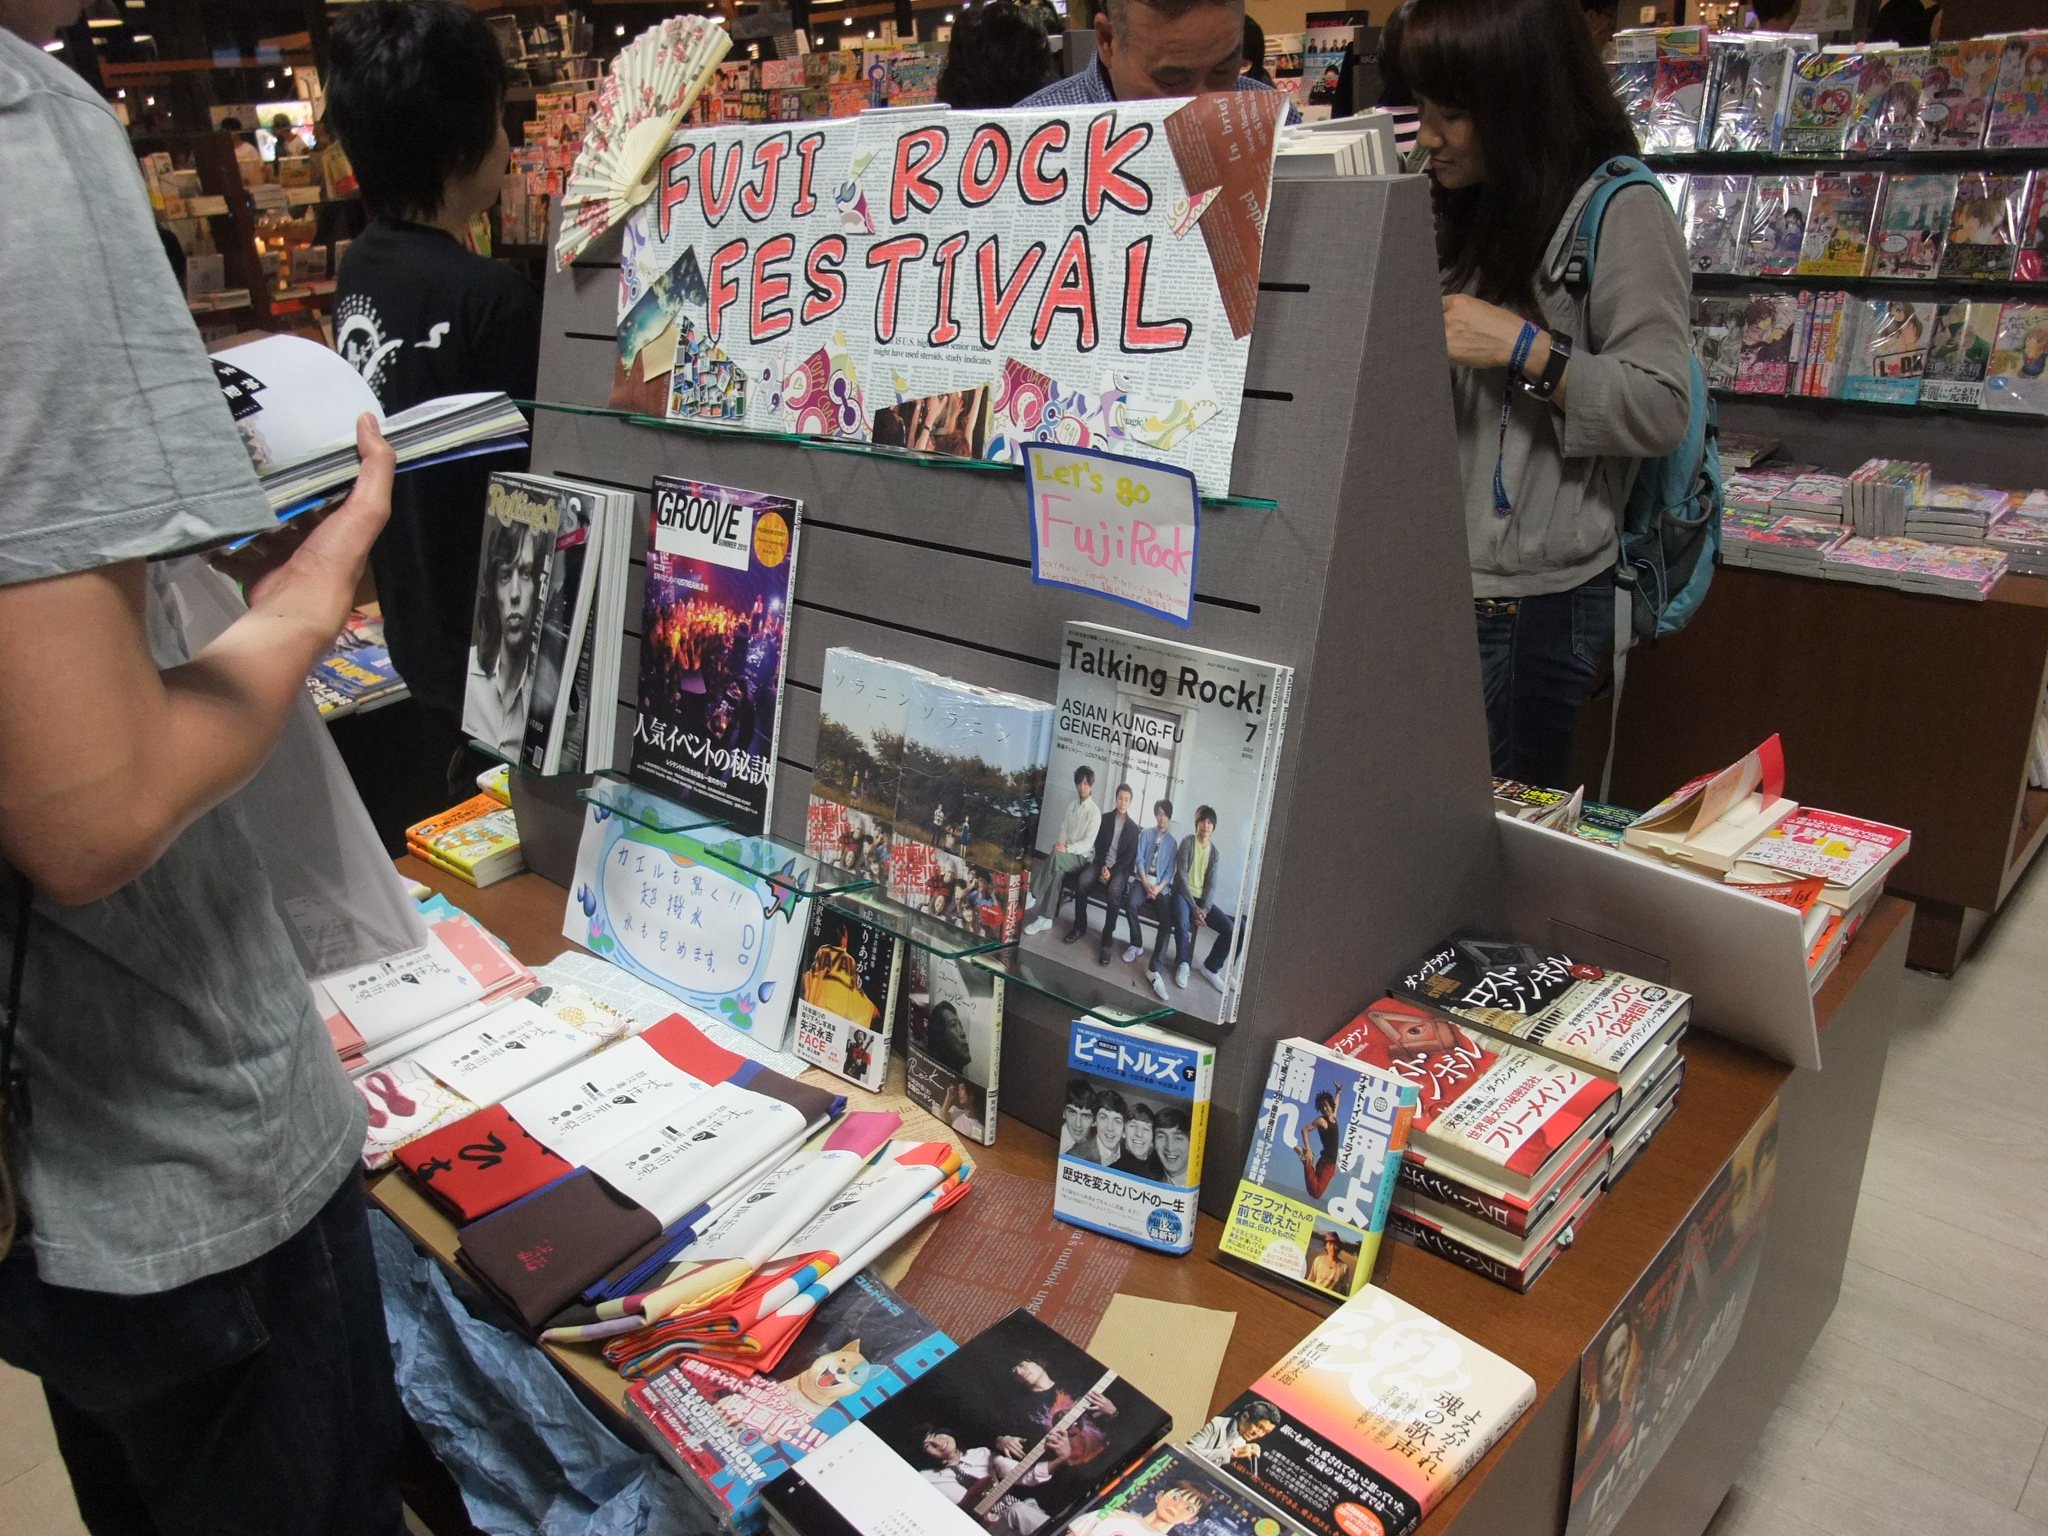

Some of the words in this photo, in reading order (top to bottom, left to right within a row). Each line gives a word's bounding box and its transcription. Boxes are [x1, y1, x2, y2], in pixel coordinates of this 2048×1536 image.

[658, 130, 825, 243] FUJI
[890, 110, 1153, 225] ROCK
[707, 225, 1192, 354] FESTIVAL
[874, 349, 890, 361] might
[891, 351, 904, 361] have
[905, 352, 919, 362] used
[945, 354, 962, 365] study
[964, 357, 992, 366] indicates
[1034, 453, 1104, 495] Let's
[1116, 476, 1150, 507] go
[657, 492, 742, 544] GROOVE
[835, 673, 910, 707] ソラニン
[1066, 640, 1168, 697] Talking
[1177, 666, 1266, 715] Rock!
[1060, 715, 1159, 756] GENERATION
[1061, 698, 1107, 723] ASIAN
[1112, 710, 1184, 744] KUNG-FU
[1245, 723, 1257, 743] 7
[633, 712, 770, 788] 人気イベントの秘訣
[808, 801, 850, 824] 映画化
[618, 847, 743, 911] カエルも驚く!!
[891, 843, 938, 869] 映画化
[640, 882, 703, 930] 超撥水
[1404, 947, 1455, 990] ダン・ブラウン
[1498, 953, 1574, 1014] シンボル
[1581, 966, 1595, 976] 下
[799, 1020, 834, 1044] 矢沢永吉
[799, 1031, 826, 1053] FACE
[1332, 1024, 1369, 1055] ブラウン
[1605, 1000, 1654, 1038] 12時間!
[1074, 1034, 1183, 1083] ビートルズ
[1185, 1070, 1195, 1079] 下
[1338, 1073, 1370, 1173] ナオト・インティライミ
[1466, 1074, 1543, 1141] 世界最大の秘密結社
[1484, 1071, 1577, 1149] フリーメイソン
[1325, 1072, 1401, 1229] 世界よ
[1062, 1166, 1185, 1213] 歴史を変えたバンドの一生
[1240, 1190, 1314, 1222] アラファトさんの
[1150, 1228, 1178, 1244] 最新刊
[1236, 1203, 1301, 1233] 前で歌えた!
[1041, 1241, 1074, 1289] outlook
[1278, 1340, 1333, 1387] 杉山裕太郎
[683, 1390, 768, 1479] ROADSHOW
[1389, 1389, 1467, 1459] 魂の歌声
[1415, 1409, 1483, 1483] よみがえれ、
